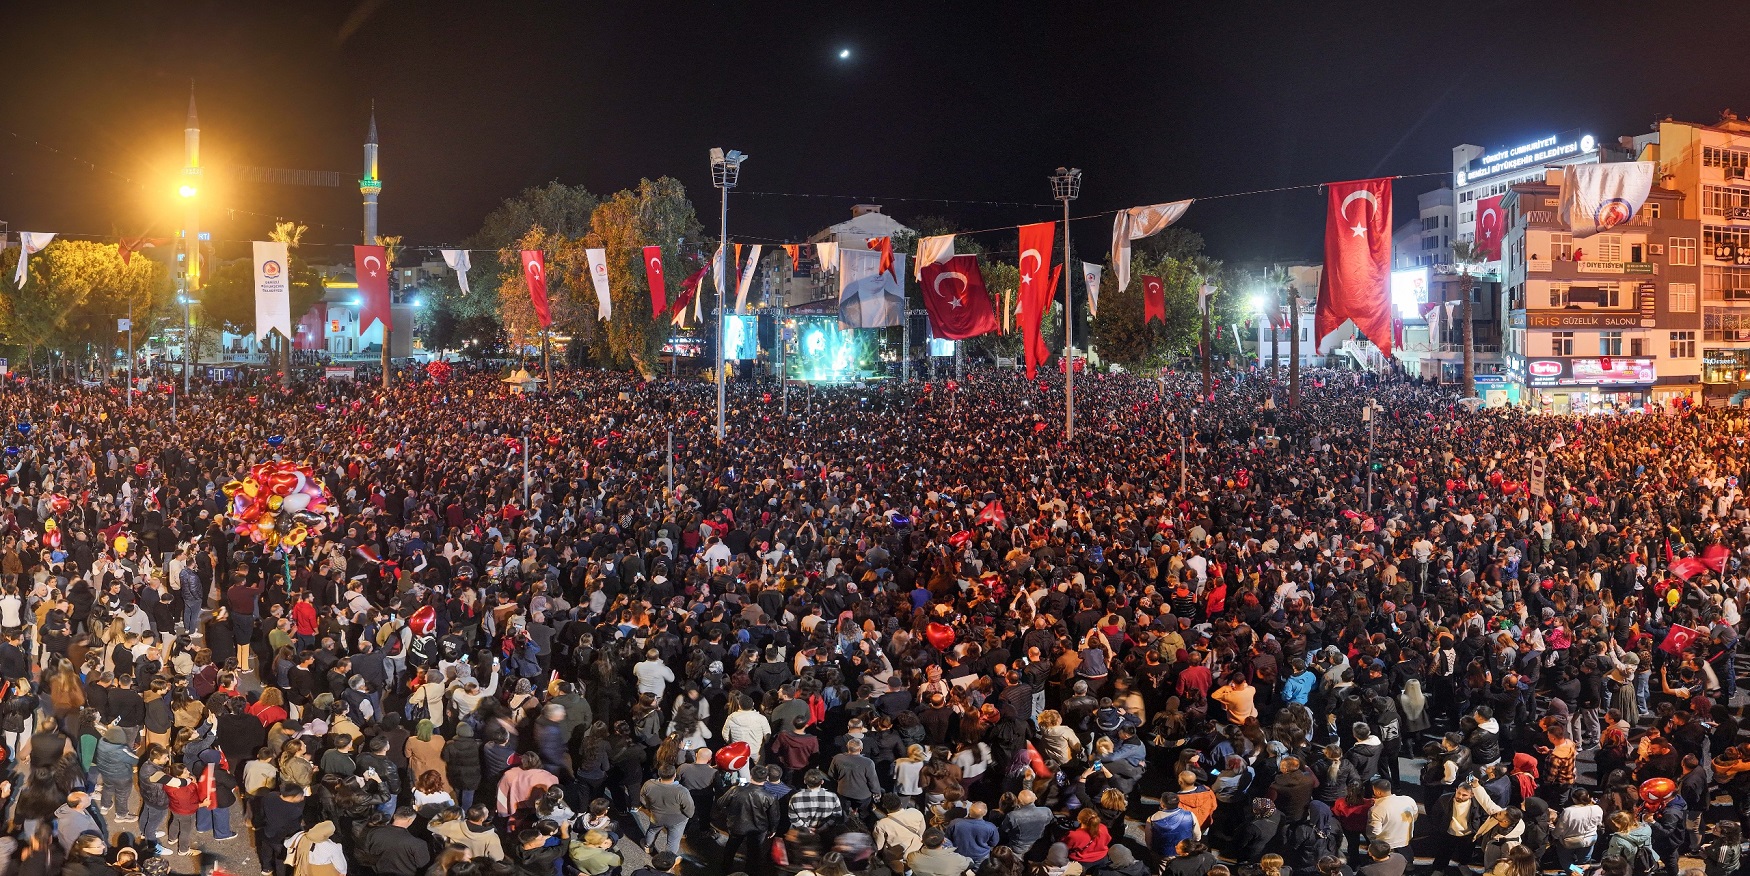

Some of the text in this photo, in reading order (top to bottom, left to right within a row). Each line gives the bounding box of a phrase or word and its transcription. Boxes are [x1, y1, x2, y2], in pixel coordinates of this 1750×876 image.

[1467, 141, 1578, 180] DENİZLİ BÜYÜKŞEHİR BELEDİYESİ
[1482, 135, 1557, 165] TÜRKİYE CUMHURİYETİ
[1562, 316, 1599, 326] GÜZELLİK
[1605, 318, 1636, 326] SALONU
